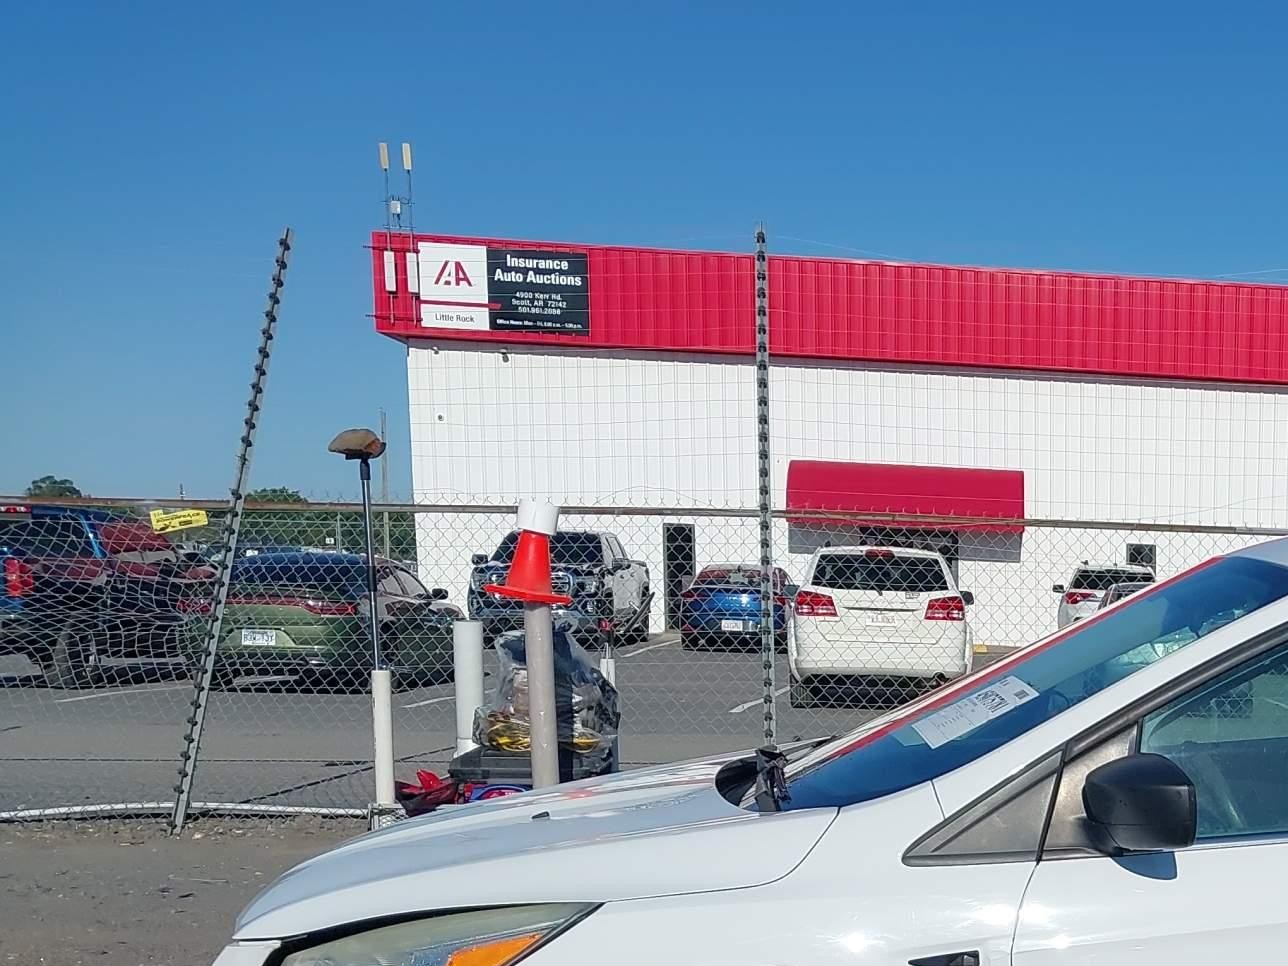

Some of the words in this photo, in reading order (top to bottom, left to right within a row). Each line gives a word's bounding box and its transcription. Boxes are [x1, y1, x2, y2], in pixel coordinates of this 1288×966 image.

[506, 254, 569, 270] Insurance
[494, 268, 523, 283] Auto
[526, 270, 582, 286] Auctions
[533, 299, 544, 307] AR
[435, 312, 454, 322] Little
[455, 314, 475, 324] Rock
